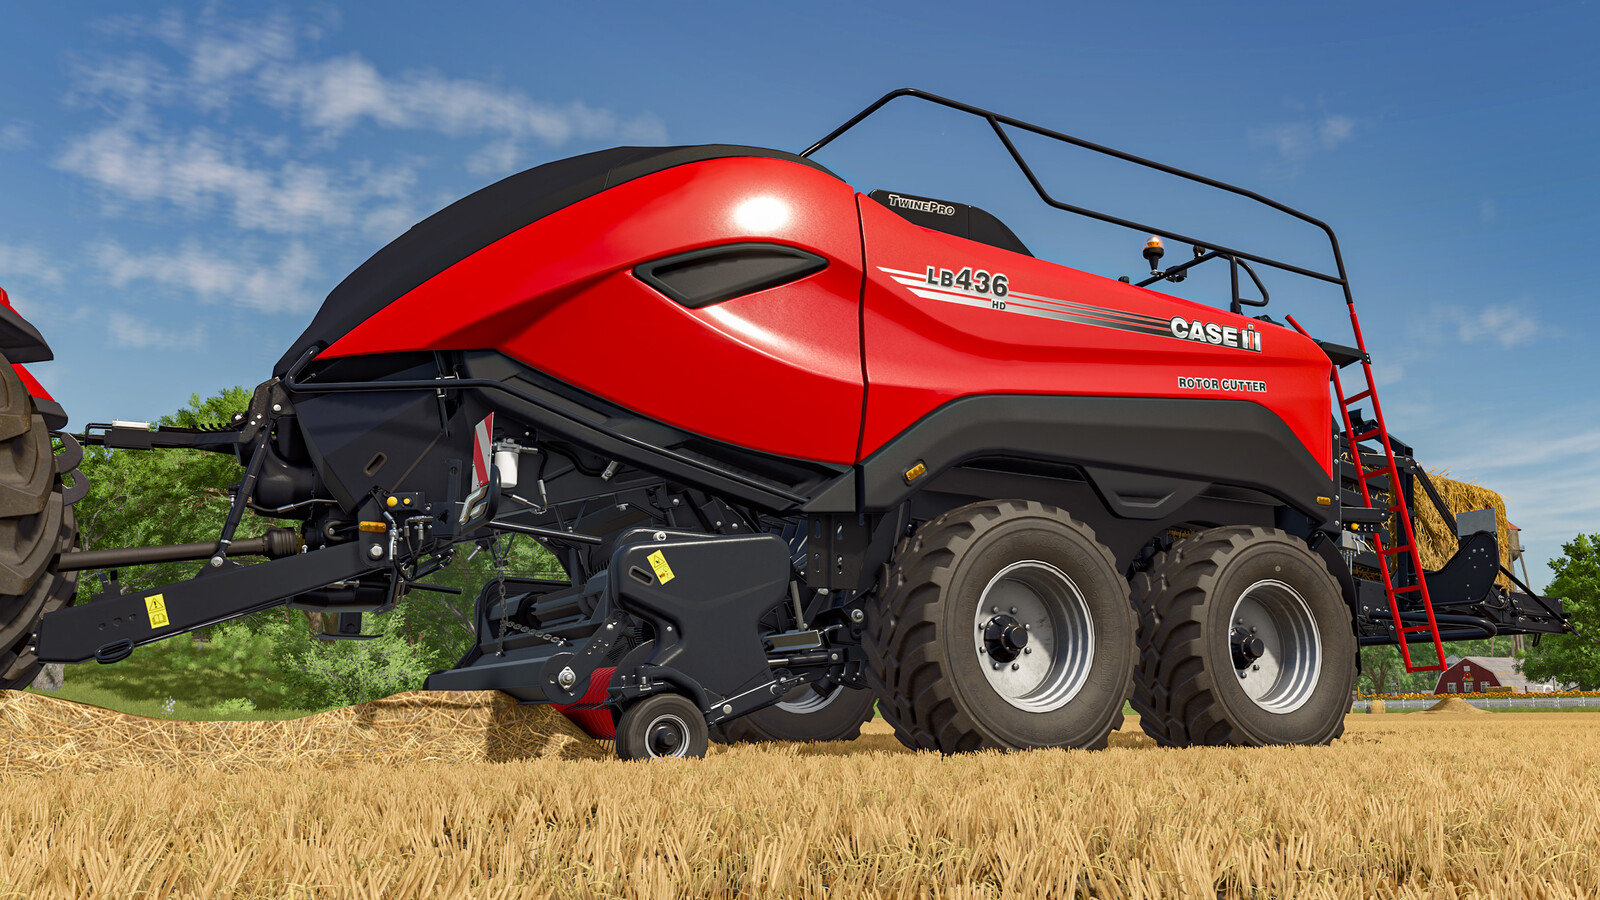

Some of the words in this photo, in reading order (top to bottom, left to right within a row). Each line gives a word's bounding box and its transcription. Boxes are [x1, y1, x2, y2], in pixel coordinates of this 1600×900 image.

[926, 265, 1009, 297] LB436
[991, 300, 1006, 310] HD
[1170, 317, 1238, 348] CASE
[1178, 376, 1219, 390] ROTOR
[1222, 379, 1267, 392] CUTTER
